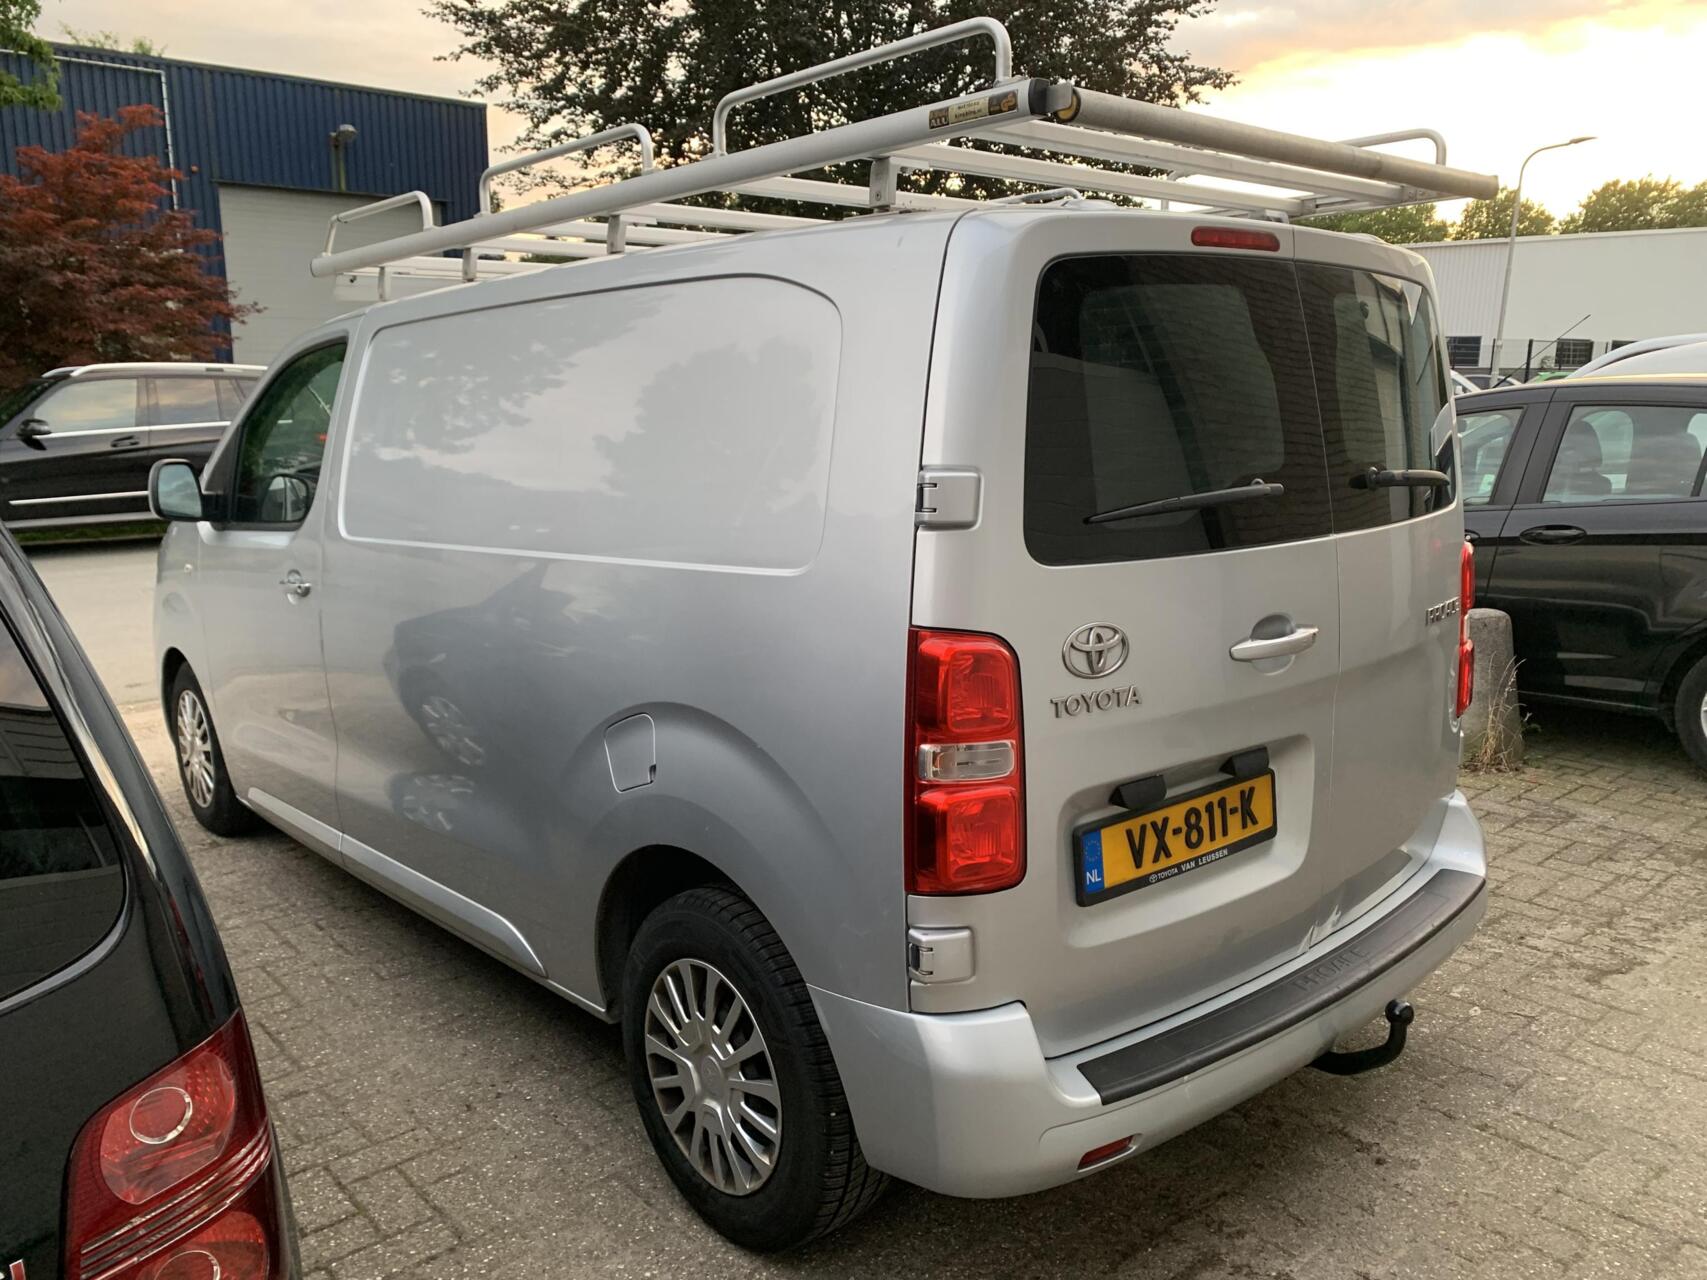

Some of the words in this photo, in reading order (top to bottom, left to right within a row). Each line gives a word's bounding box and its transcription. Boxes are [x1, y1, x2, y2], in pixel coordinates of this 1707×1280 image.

[1050, 684, 1142, 719] TOYOTA
[1125, 786, 1259, 869] VX-811-K
[1086, 869, 1102, 885] NL
[1157, 867, 1179, 880] TOYOTA
[1181, 860, 1196, 872] VAN
[1198, 848, 1228, 866] LEUSSEN
